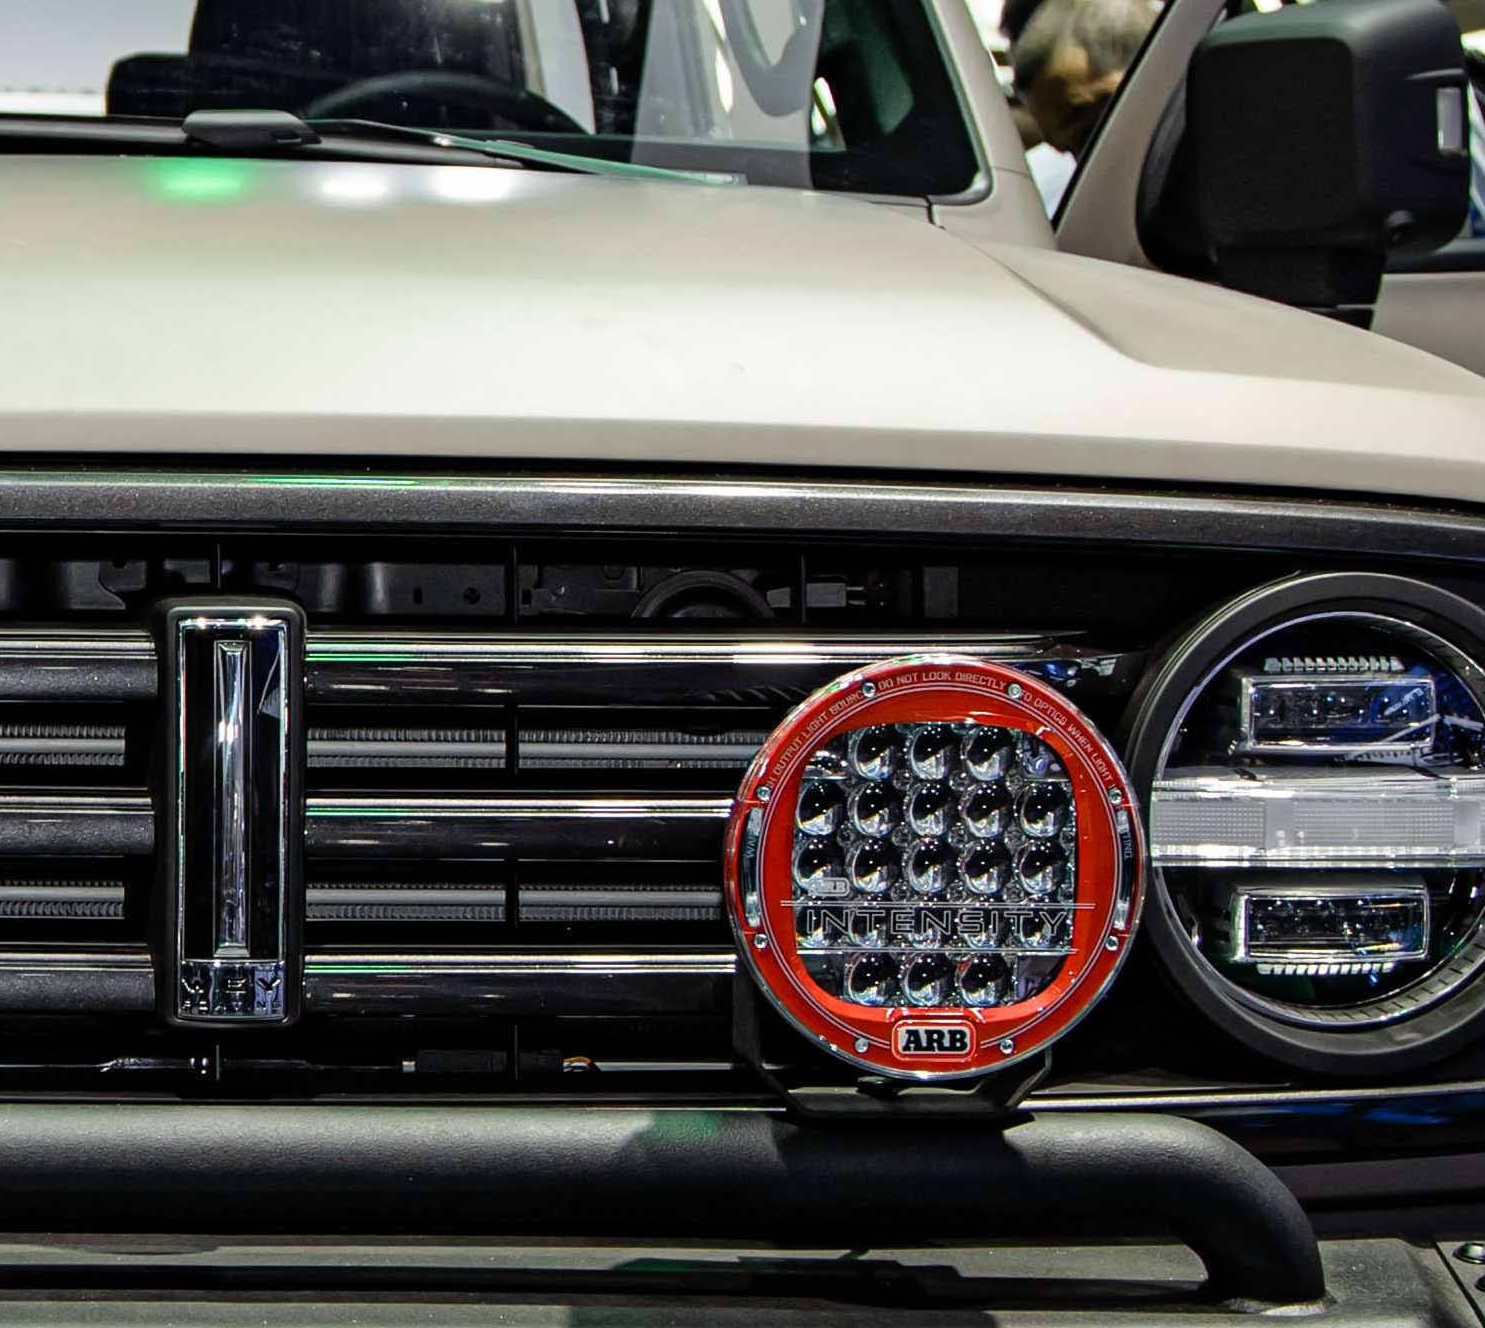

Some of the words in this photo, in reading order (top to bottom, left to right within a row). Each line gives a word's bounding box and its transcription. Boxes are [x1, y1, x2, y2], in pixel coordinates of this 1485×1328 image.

[772, 736, 803, 777] OUTPUT
[803, 709, 831, 737] LIGHT
[827, 689, 864, 716] SOURC
[877, 676, 894, 691] DO
[895, 672, 917, 685] NOT
[922, 670, 951, 681] LOOK
[955, 670, 1006, 692] DIRECTLY
[1032, 697, 1068, 726] OPTICS
[1065, 723, 1095, 754] WHEN
[1089, 751, 1114, 784] LIGHT
[806, 908, 1068, 937] INTENSITY
[901, 1028, 969, 1053] ARB
